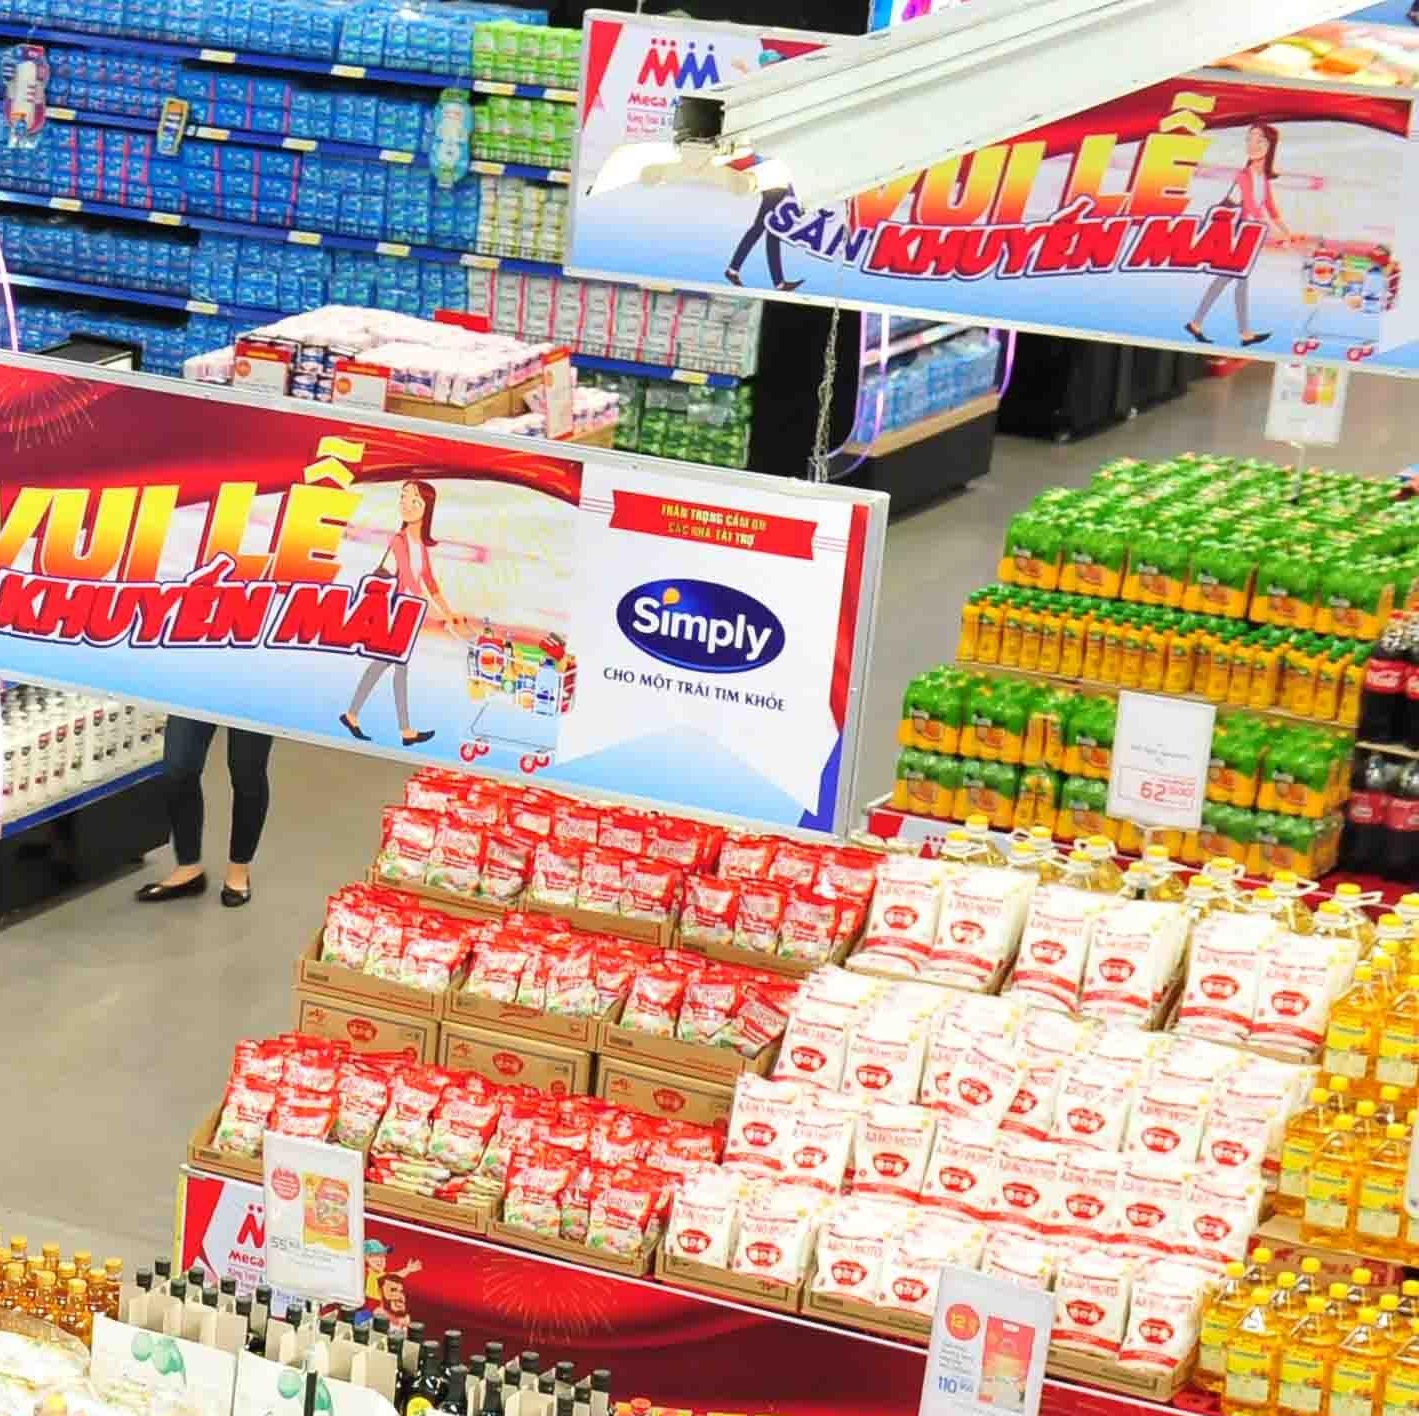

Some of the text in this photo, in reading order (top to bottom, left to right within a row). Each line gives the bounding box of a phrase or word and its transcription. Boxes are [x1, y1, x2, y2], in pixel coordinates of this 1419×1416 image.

[1067, 91, 1217, 220] LỄ
[867, 197, 1264, 277] KHUYẾN MÃI
[201, 436, 365, 584] LỄ
[271, 577, 425, 661] MÃI
[631, 586, 774, 661] Simply
[603, 666, 787, 713] CHO MỘT TRÁI TIM KHỎE
